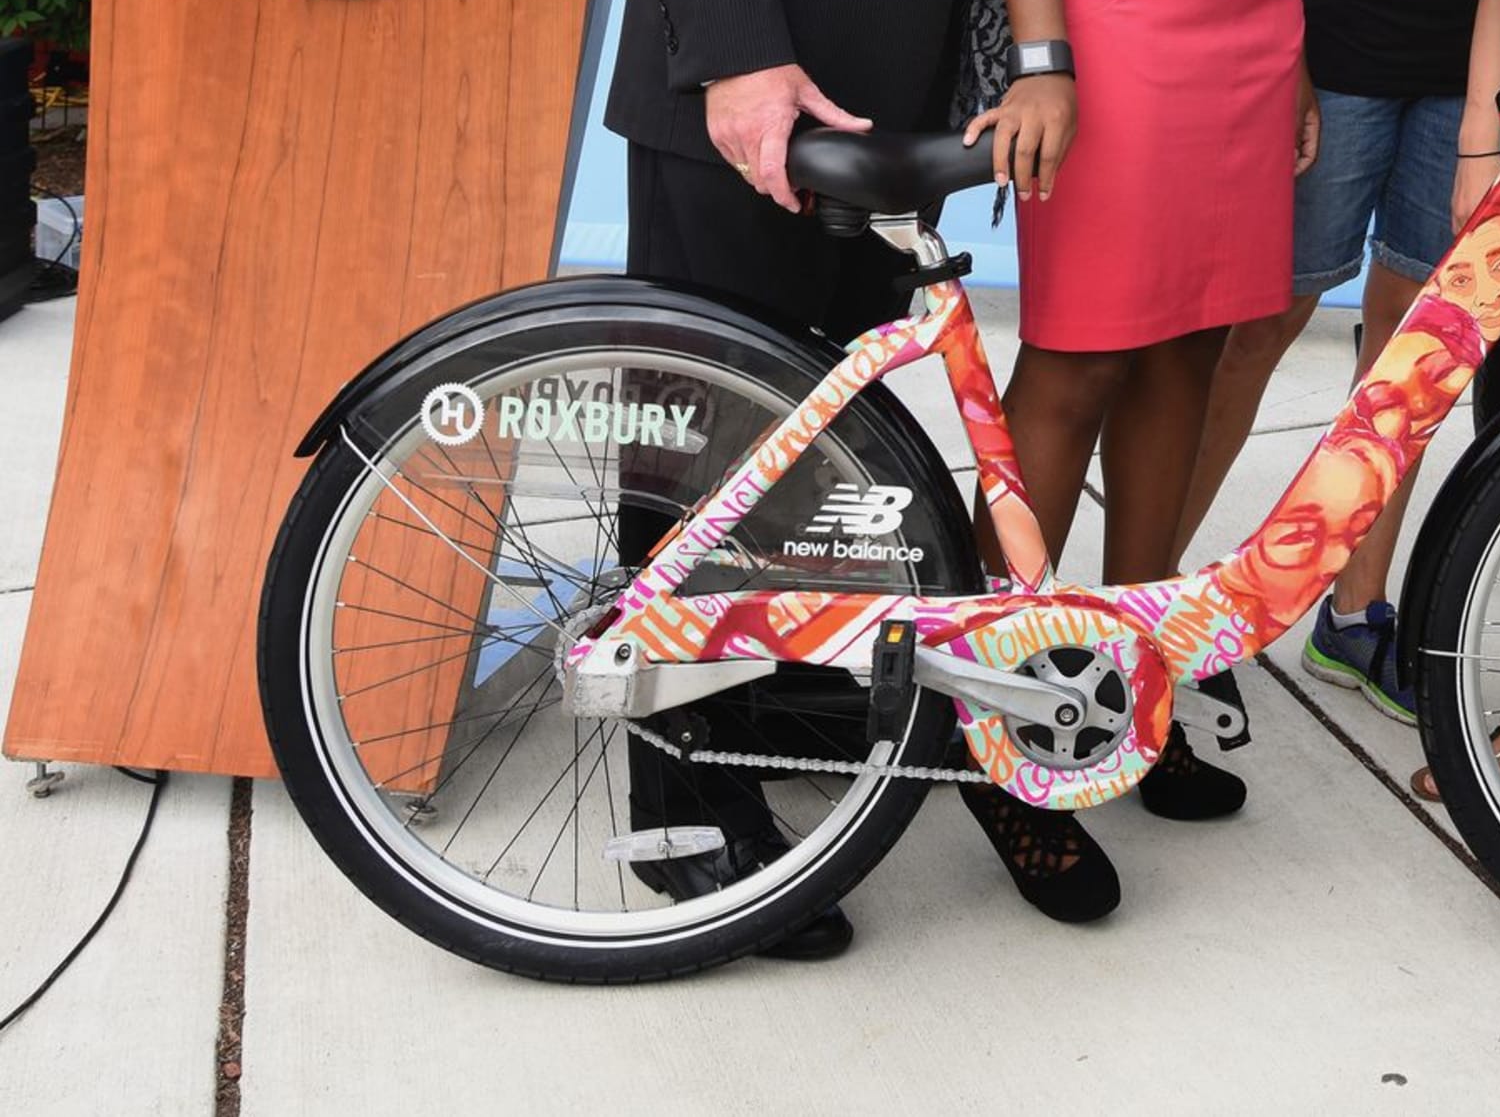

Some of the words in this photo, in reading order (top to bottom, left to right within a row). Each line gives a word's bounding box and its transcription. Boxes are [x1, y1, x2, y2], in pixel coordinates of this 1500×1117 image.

[498, 396, 697, 447] ROXBURY
[783, 540, 830, 558] new
[833, 537, 924, 563] balance
